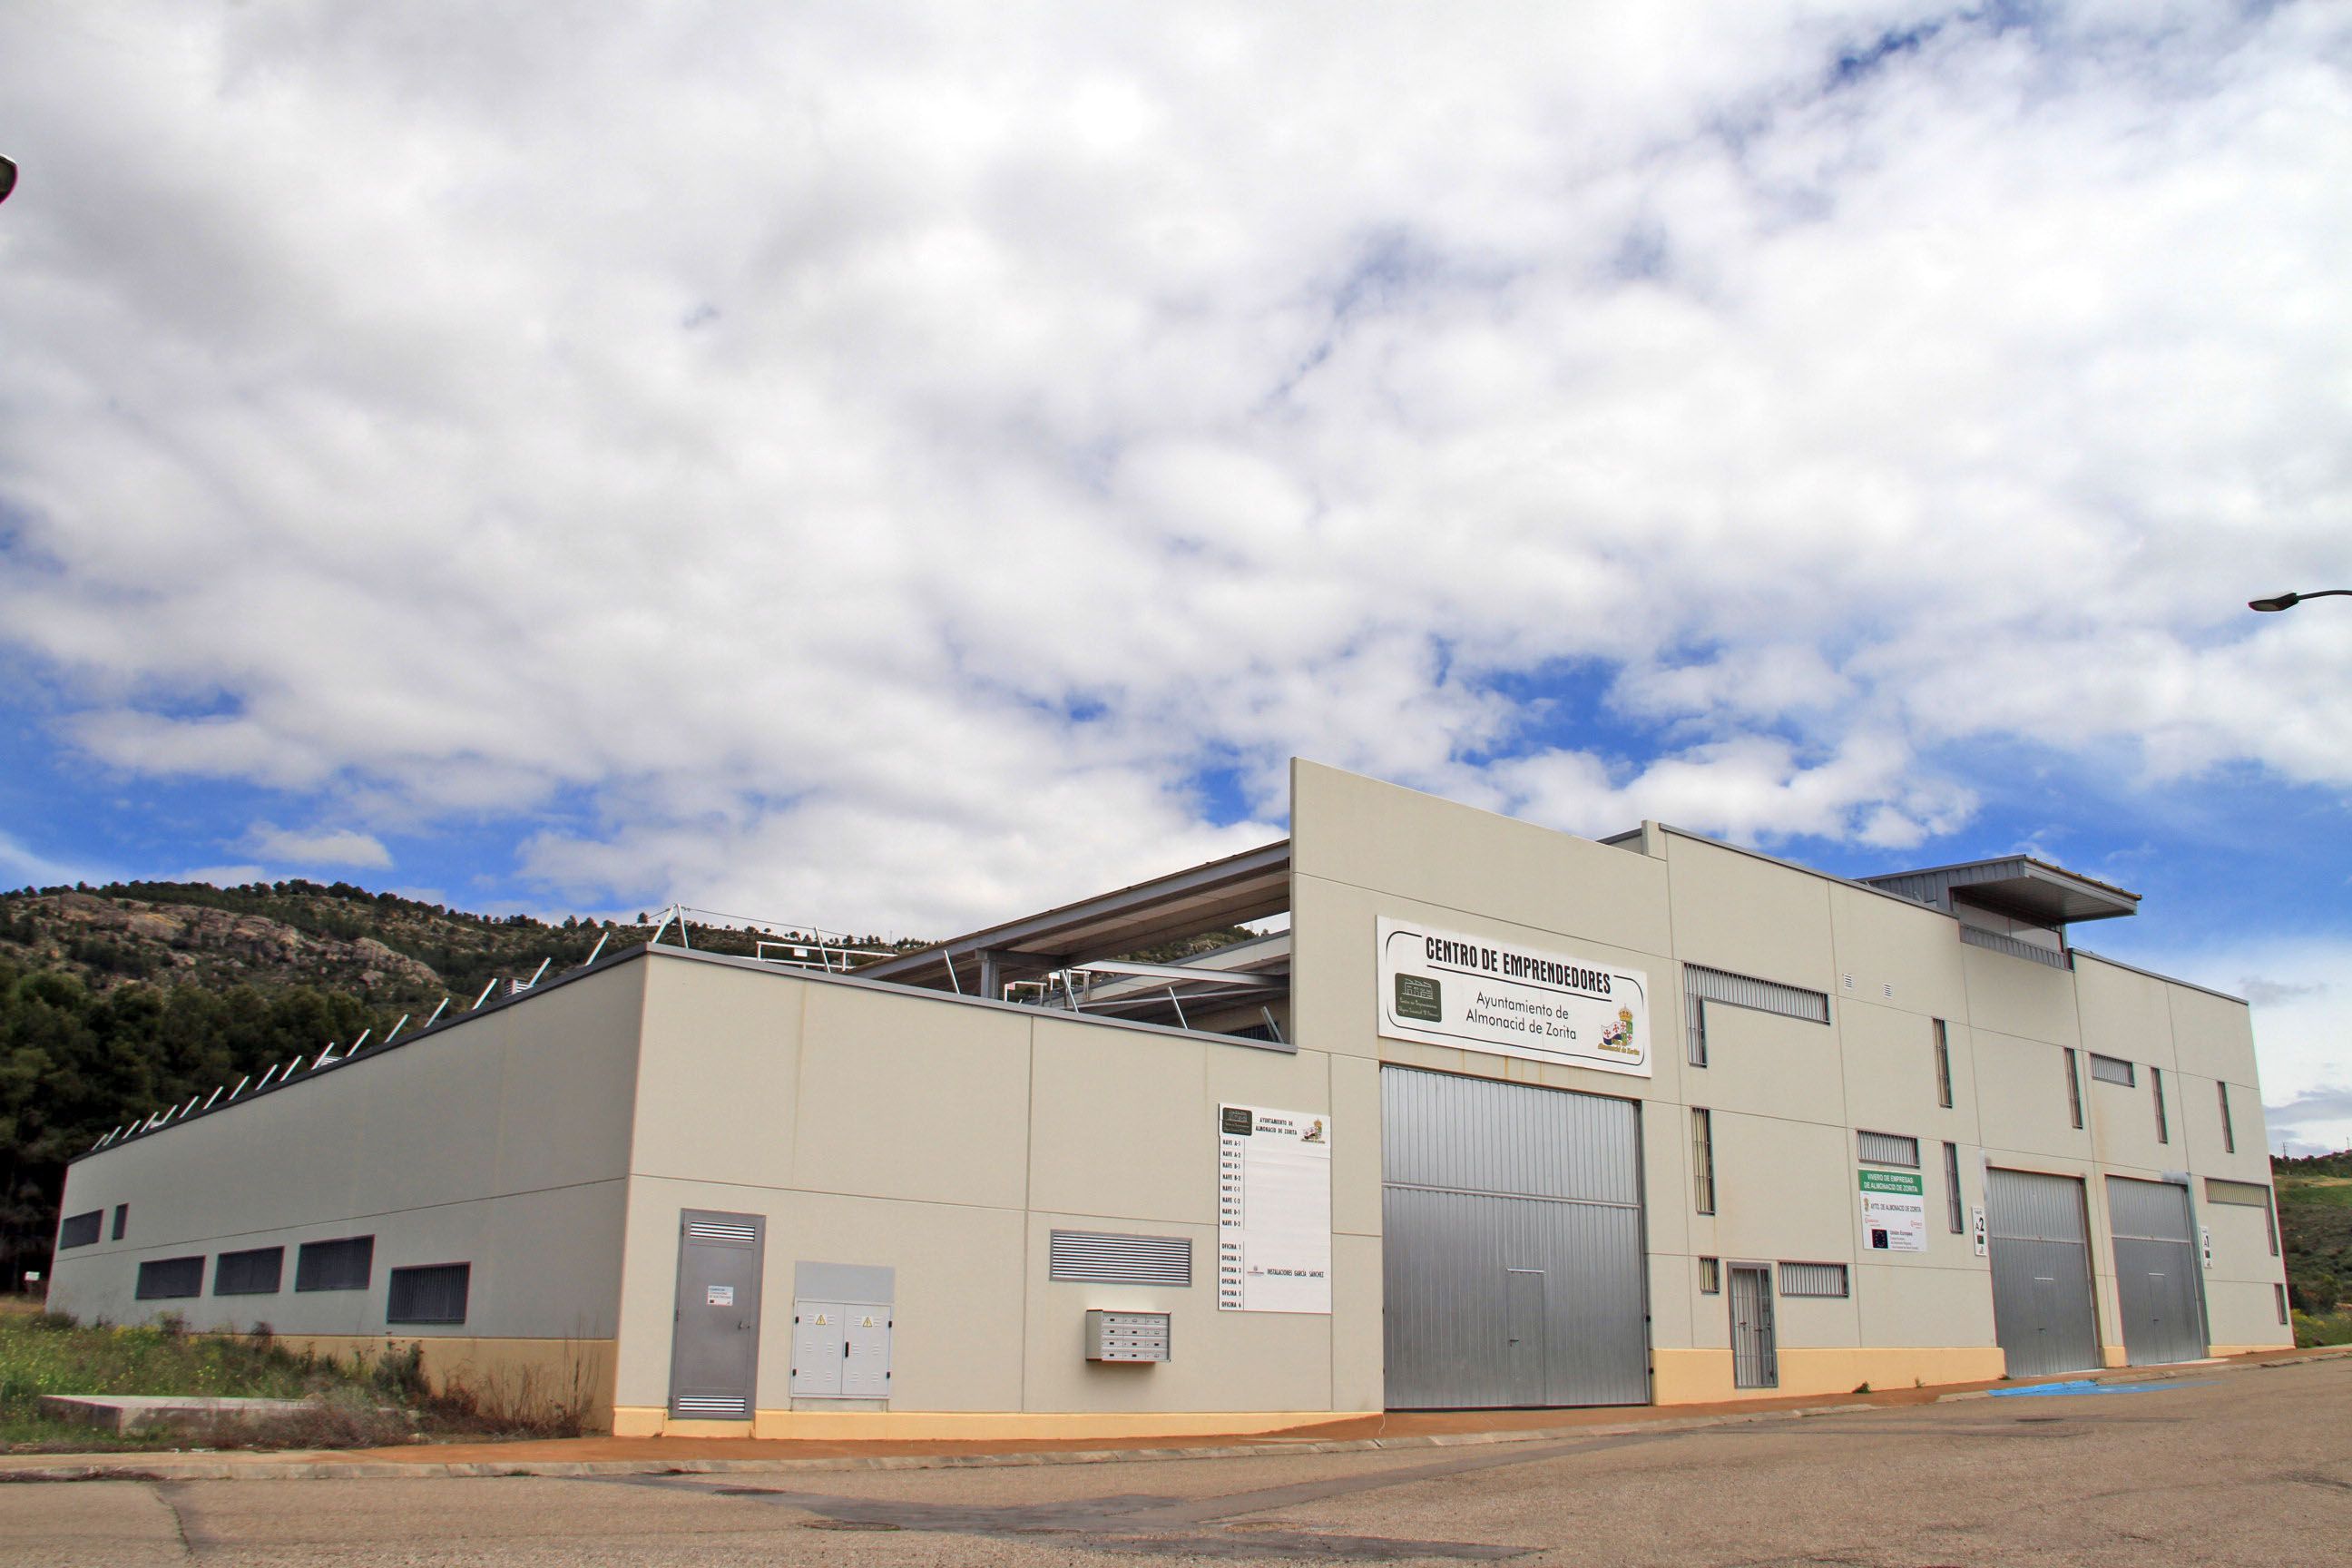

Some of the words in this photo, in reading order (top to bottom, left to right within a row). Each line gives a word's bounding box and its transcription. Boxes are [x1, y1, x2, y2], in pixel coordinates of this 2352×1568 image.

[1426, 936, 1477, 968] CENTRO
[1482, 948, 1498, 972] DE
[1503, 953, 1611, 995] EMPRENDEDORES
[1476, 991, 1553, 1017] Ayuntamiento
[1555, 1004, 1569, 1019] de
[1466, 1008, 1524, 1032] Almonacid
[1529, 1019, 1543, 1034] de
[1546, 1022, 1576, 1040] Zorita
[1259, 1117, 1288, 1126] AYUNTAMIENTO
[1255, 1125, 1277, 1133] ALMONACID
[1284, 1128, 1298, 1136] ZORITA
[1867, 1173, 1883, 1181] VIVERO
[1890, 1175, 1914, 1184] EMPRESAS
[1870, 1182, 1896, 1191] ALMONACID
